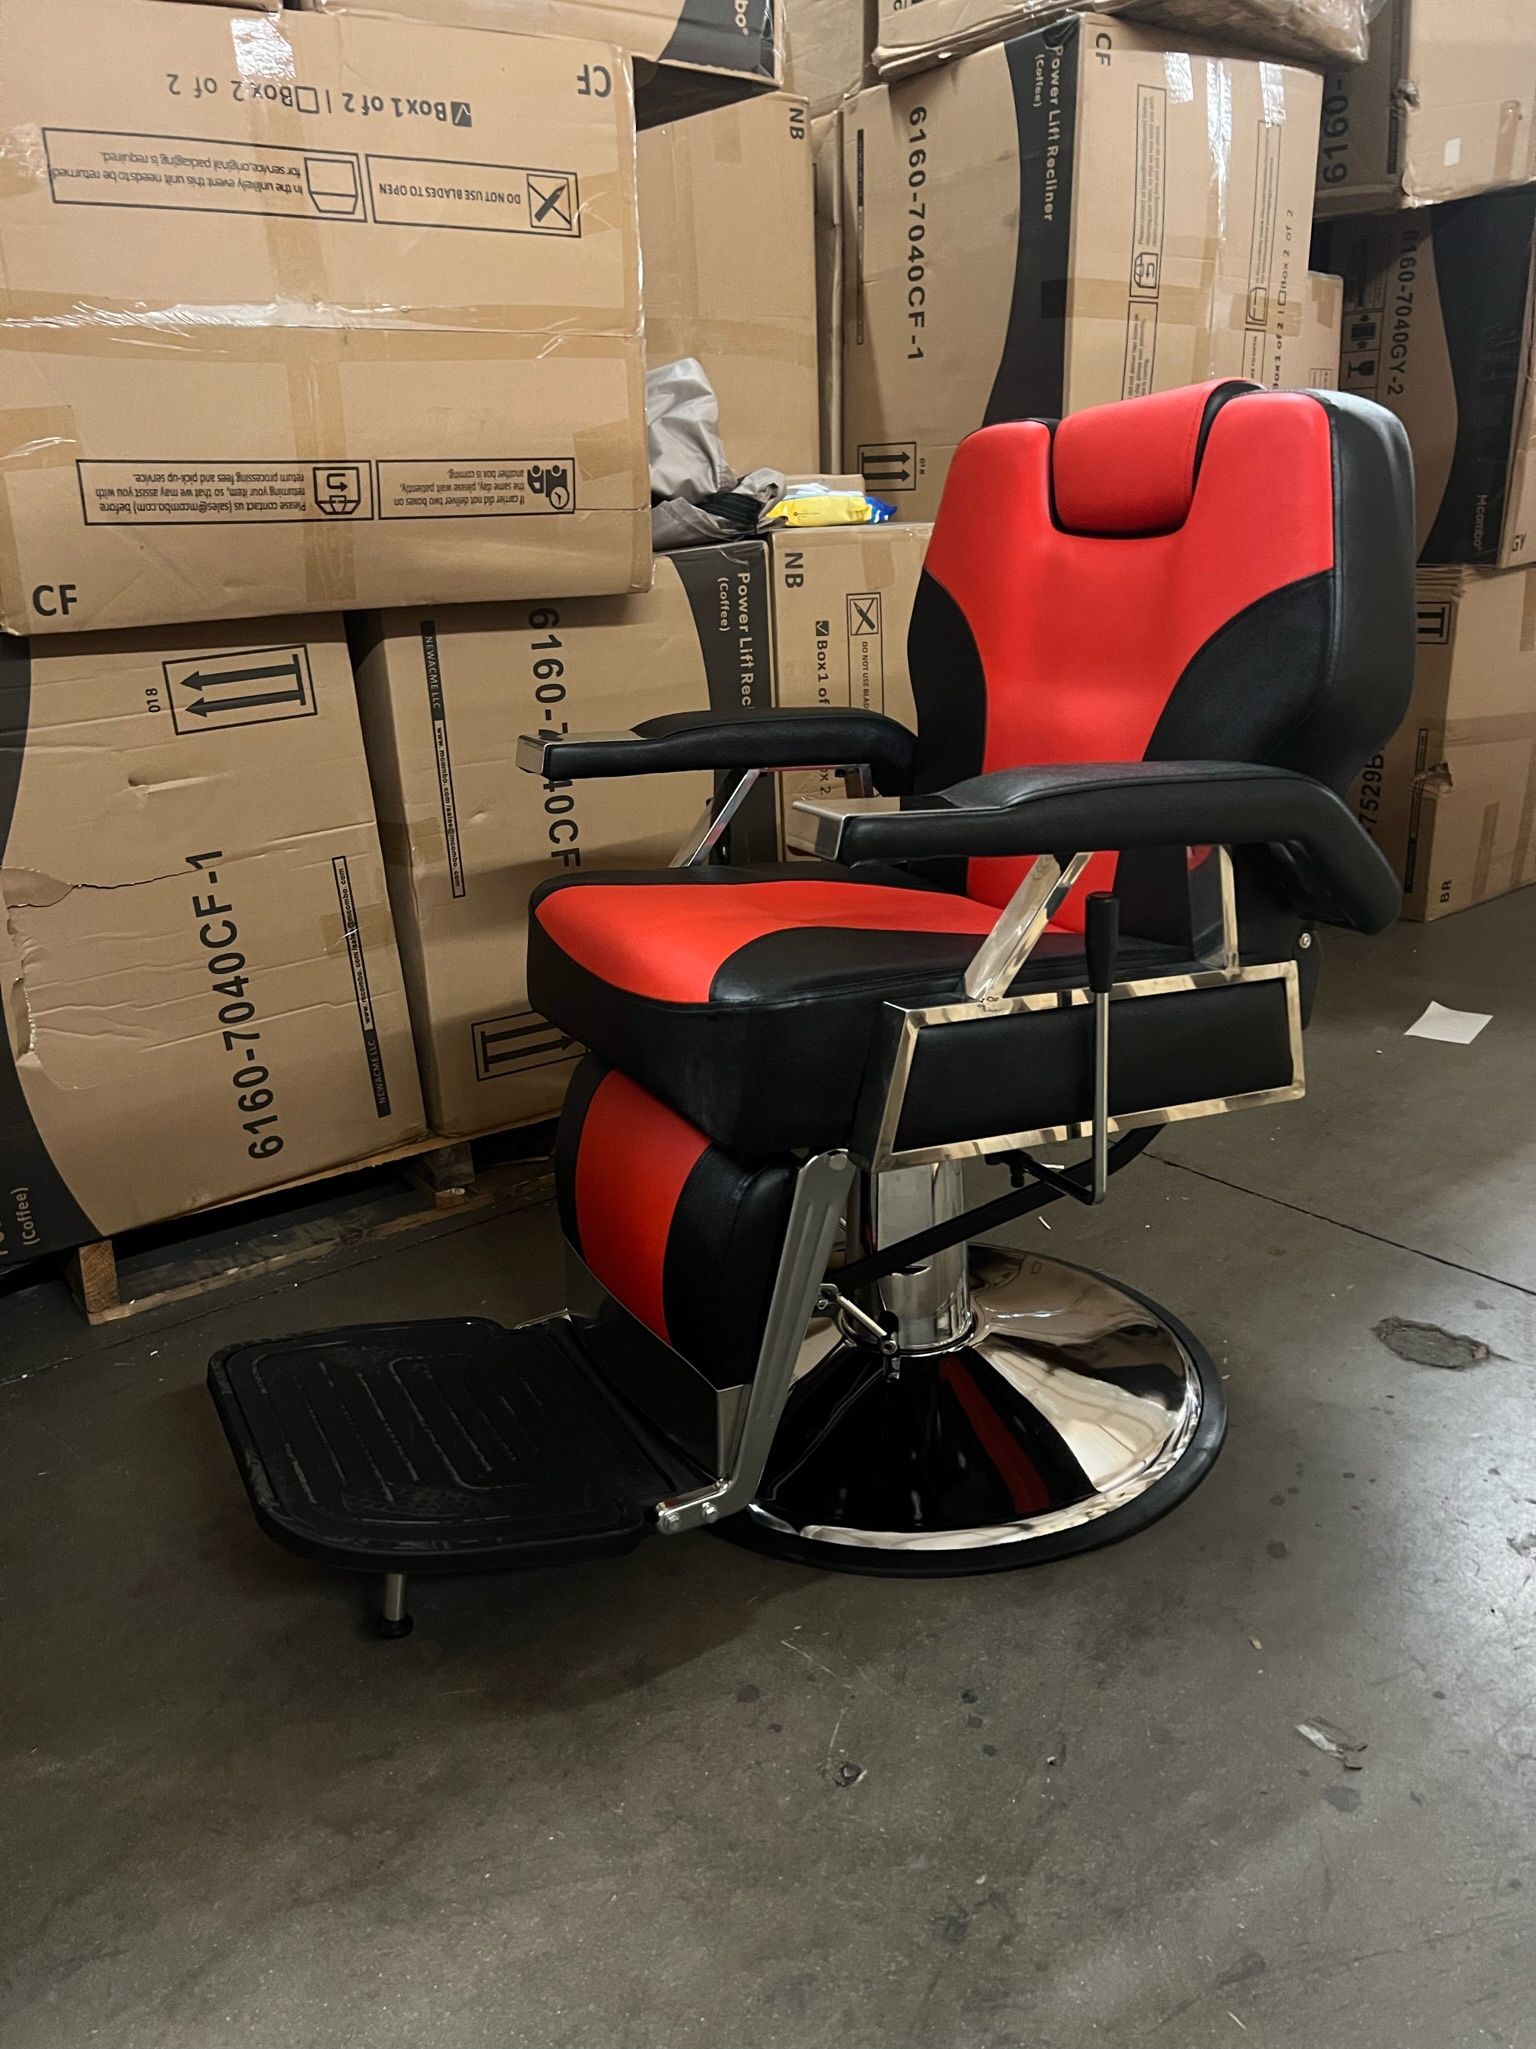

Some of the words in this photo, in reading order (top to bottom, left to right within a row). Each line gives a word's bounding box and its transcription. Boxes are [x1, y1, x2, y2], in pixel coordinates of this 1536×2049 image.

[1096, 32, 1112, 66] CF
[577, 64, 611, 98] CF
[1048, 46, 1064, 105] Power
[166, 75, 180, 95] 2
[193, 78, 217, 99] of
[231, 81, 243, 101] 2
[252, 83, 294, 107] Box
[341, 93, 354, 113] 2
[363, 95, 384, 116] of
[789, 108, 804, 139] NB
[1047, 109, 1061, 140] Lift
[160, 155, 211, 170] packaging
[52, 168, 100, 179] returned
[103, 171, 117, 181] be
[287, 167, 301, 178] for
[164, 175, 184, 186] unit
[187, 176, 205, 188] this
[208, 178, 235, 189] event
[237, 179, 273, 192] unlikely
[1044, 146, 1059, 221] Recliner
[276, 183, 291, 194] the
[294, 185, 303, 195] In
[380, 183, 407, 195] OPEN
[410, 185, 422, 196] TO
[425, 187, 462, 200] BLADES
[465, 190, 483, 201] USE
[486, 191, 505, 202] NOT
[507, 193, 520, 204] DO
[1286, 209, 1294, 217] 2
[908, 106, 926, 359] 6160-7040CF-1
[1284, 224, 1292, 241] of
[168, 472, 198, 486] pick-up
[200, 474, 215, 485] and
[217, 474, 234, 485] fees
[237, 472, 278, 484] processing
[280, 474, 304, 484] return
[483, 470, 496, 480] box
[498, 470, 524, 479] another
[117, 487, 133, 498] you
[160, 487, 178, 497] may
[227, 487, 247, 498] item,
[250, 487, 267, 498] your
[269, 486, 305, 498] returning
[437, 484, 451, 493] wait
[454, 482, 476, 492] please
[494, 483, 512, 491] same
[514, 483, 524, 491] the
[96, 489, 115, 499] with
[135, 488, 158, 498] assist
[180, 489, 192, 497] we
[195, 489, 212, 499] that
[214, 489, 224, 498] so
[406, 498, 427, 507] boxes
[429, 497, 442, 505] two
[444, 497, 469, 506] deliver
[470, 496, 482, 504] not
[484, 496, 495, 505] did
[496, 495, 518, 504] carrier
[100, 503, 130, 513] before
[234, 502, 244, 511] us
[247, 502, 278, 512] contact
[280, 502, 306, 512] Please
[785, 552, 804, 589] NB
[32, 584, 77, 616] CF
[717, 577, 730, 631] (Coffee)
[737, 572, 751, 632] Power
[739, 637, 755, 668] Lift
[861, 641, 868, 653] DO
[861, 655, 869, 671] NOT
[425, 636, 439, 690] NEWACME
[432, 692, 441, 709] LLC
[862, 672, 870, 686] USE
[145, 688, 160, 712] 018
[818, 688, 830, 705] of
[820, 786, 831, 794] 2
[1440, 880, 1452, 903] BR
[185, 850, 283, 1159] 6160-7040CF-1
[367, 1039, 378, 1055] LLC
[369, 1056, 387, 1104] NEWACME
[10, 1188, 40, 1245] (Coffee)
